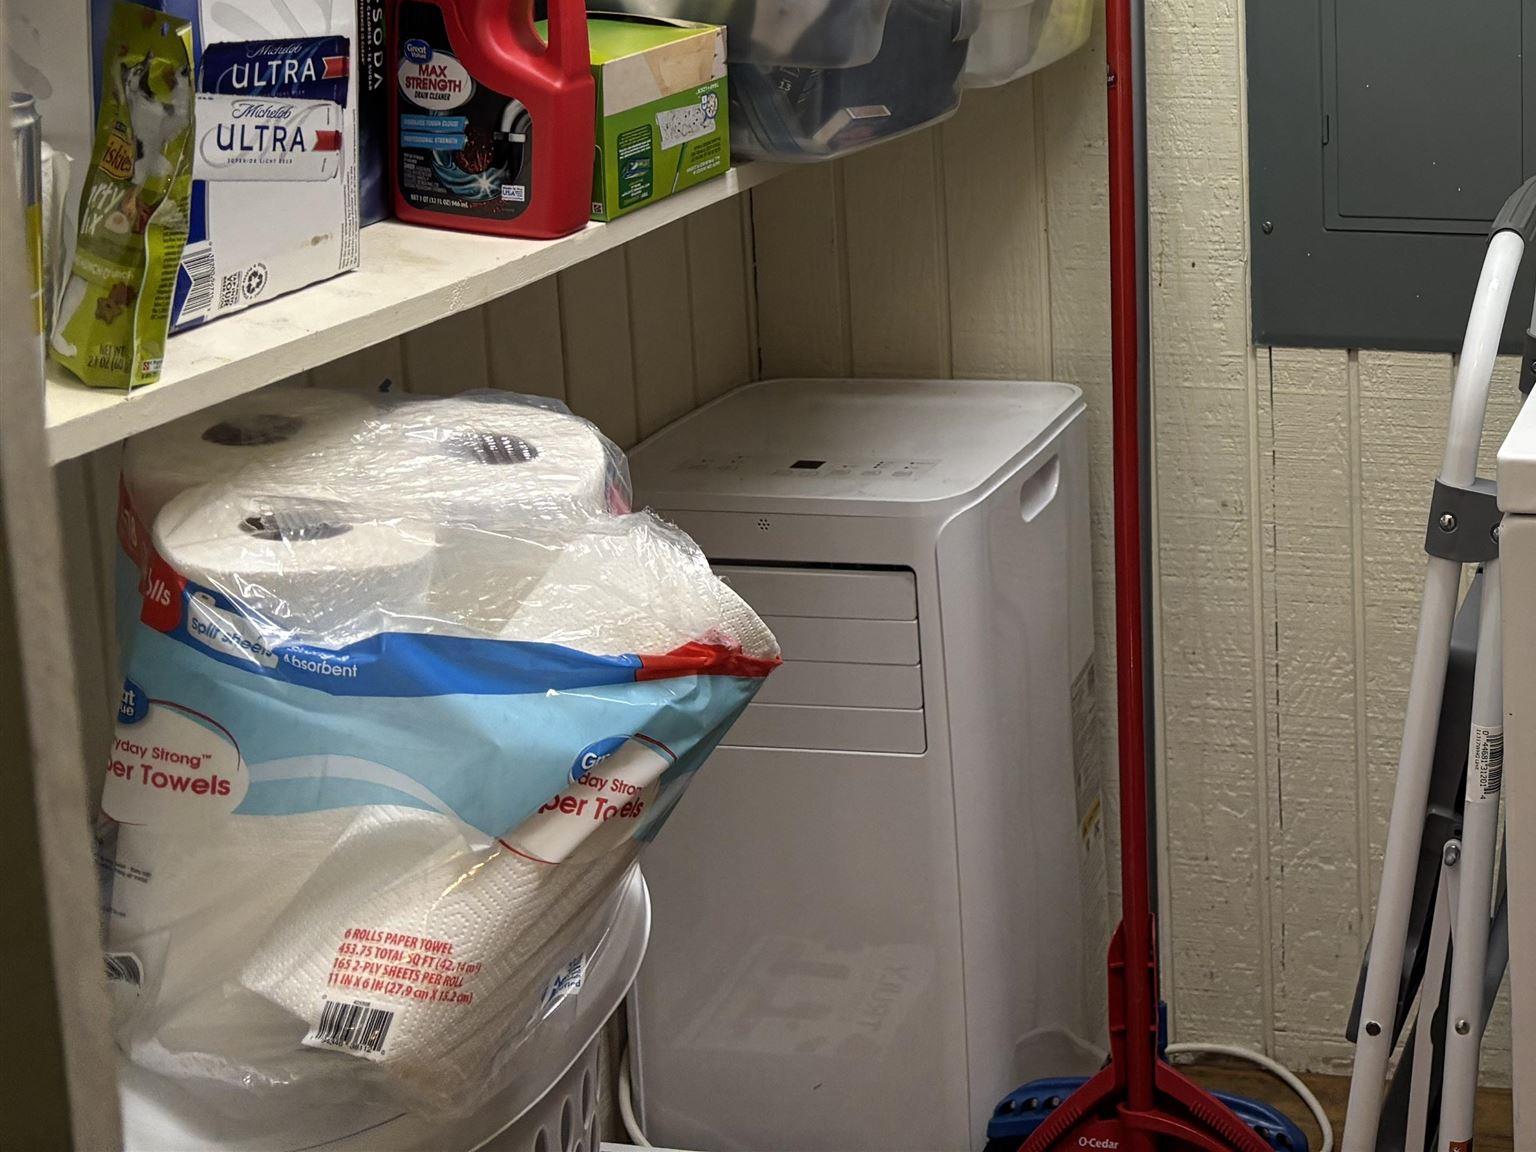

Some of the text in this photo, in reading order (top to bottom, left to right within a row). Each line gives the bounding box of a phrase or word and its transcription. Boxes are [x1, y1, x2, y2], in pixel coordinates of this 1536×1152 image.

[246, 42, 302, 59] Michelob
[407, 44, 427, 54] Great
[232, 57, 316, 89] ULTRA
[418, 64, 447, 78] MAX
[405, 76, 462, 93] STRENGTH
[232, 102, 295, 120] Michelob
[216, 123, 306, 152] ULTRA
[102, 147, 132, 173] iskies
[141, 764, 231, 796] Towels
[594, 796, 645, 822] Toels
[344, 928, 455, 955] 6 ROLLS PAPER TOWEL
[338, 942, 372, 957] 453.75
[374, 946, 404, 962] TOTAL
[421, 954, 435, 967] FT
[328, 972, 339, 985] 11
[340, 974, 352, 986] IN
[352, 975, 361, 987] X
[362, 976, 370, 988] 6
[371, 978, 384, 991] IN
[333, 957, 464, 988] 165 2-PLY SHEETS PER ROLL
[1079, 1137, 1120, 1150] O-Cedar
